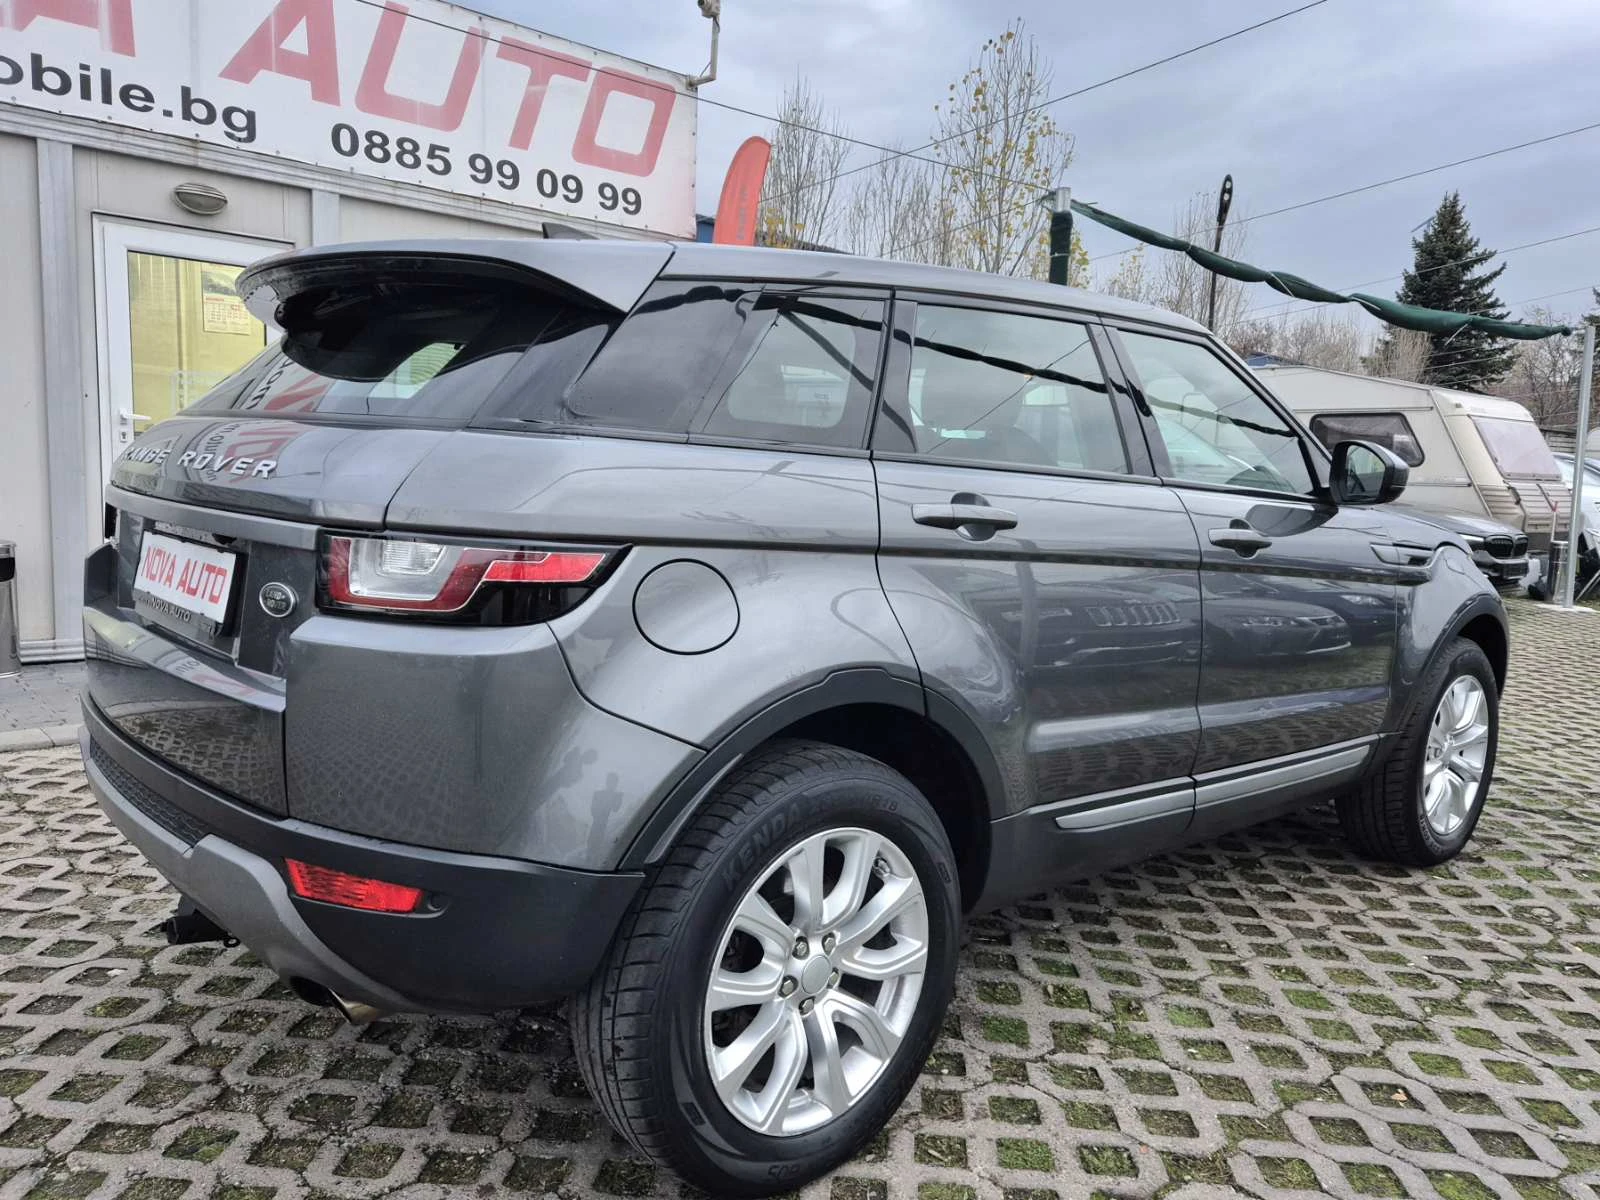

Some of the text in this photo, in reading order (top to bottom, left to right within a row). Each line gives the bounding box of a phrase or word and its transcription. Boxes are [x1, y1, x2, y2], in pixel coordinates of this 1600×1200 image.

[218, 0, 678, 177] AUTO
[331, 122, 643, 216] 0885 99 09 99
[177, 450, 278, 480] ROVER
[141, 545, 228, 605] NOVA AUTO
